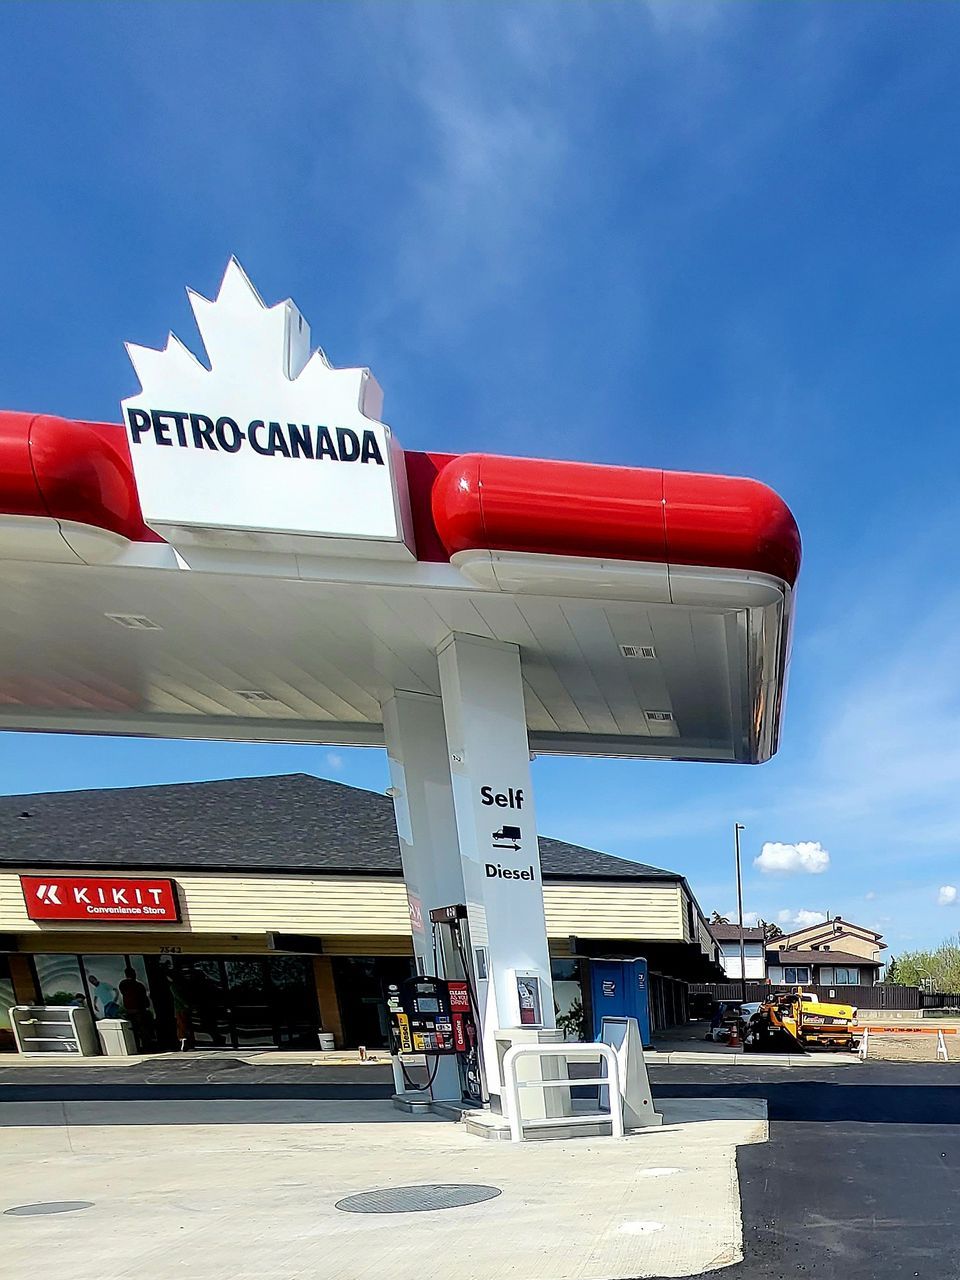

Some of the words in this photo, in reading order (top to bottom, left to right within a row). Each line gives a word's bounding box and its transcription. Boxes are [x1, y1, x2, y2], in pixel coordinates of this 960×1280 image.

[127, 408, 385, 466] PETRO-CANADA
[481, 786, 524, 809] Self
[485, 863, 535, 881] Diesel
[73, 887, 162, 904] KIKIT
[86, 905, 141, 914] Convenience
[143, 906, 166, 914] Store
[400, 1023, 411, 1049] Diesel
